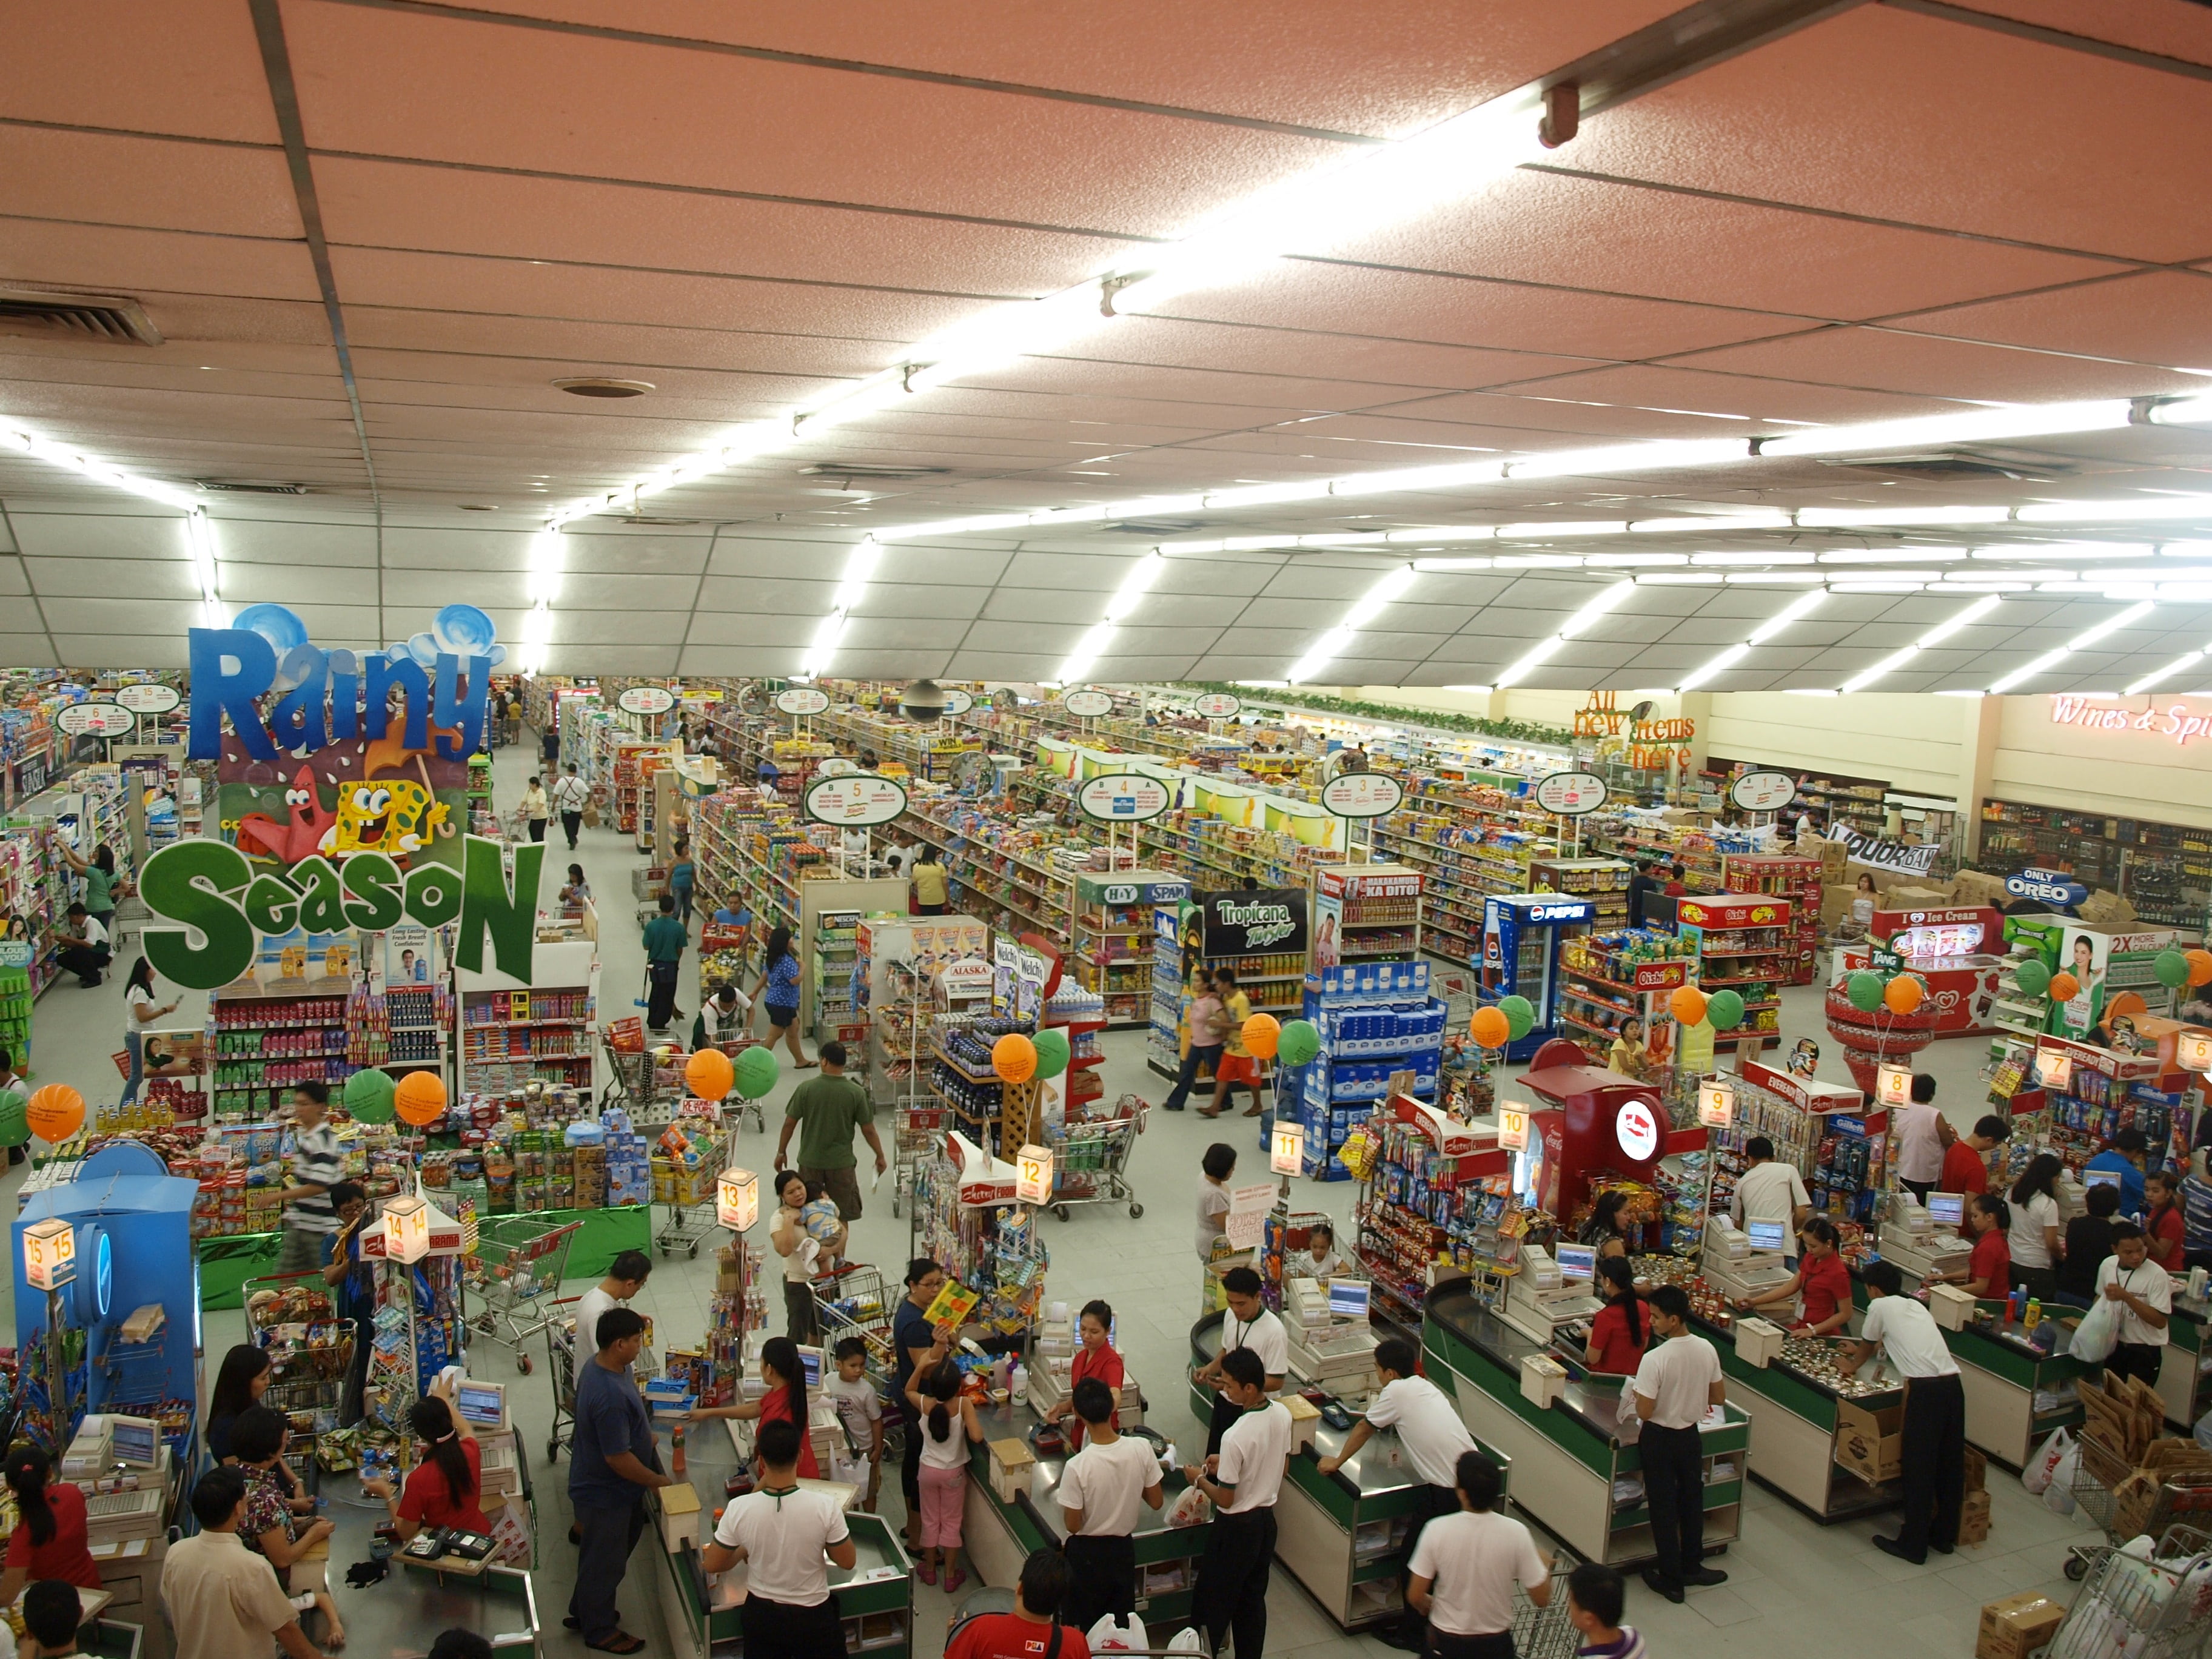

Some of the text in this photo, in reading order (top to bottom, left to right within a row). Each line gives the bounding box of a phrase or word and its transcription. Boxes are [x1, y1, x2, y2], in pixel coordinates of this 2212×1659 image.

[143, 688, 152, 697] 15
[189, 628, 491, 763] Rainy
[1587, 690, 1616, 711] All
[93, 708, 99, 718] 6
[2051, 695, 2212, 745] Wines & Spi
[1573, 710, 1627, 736] new
[1636, 718, 1696, 742] items
[938, 737, 957, 746] WIN
[1633, 742, 1692, 770] here
[853, 783, 861, 797] 5
[1121, 780, 1127, 794] 4
[1360, 779, 1366, 792] 3
[1570, 778, 1576, 790] 2
[1763, 777, 1768, 788] 1
[1905, 848, 1937, 869] BAN
[1367, 877, 1420, 886] MAKAKAMURA
[2023, 869, 2054, 882] ONLY
[1152, 885, 1187, 900] SPAM
[1367, 885, 1420, 897] KA DITO!
[2007, 878, 2070, 902] OREO
[1217, 901, 1290, 926] Tropicana
[1544, 905, 1585, 919] PEPSI
[1725, 909, 1747, 920] Oishi
[1902, 911, 1978, 924] I Ice Cream
[407, 928, 427, 936] Lasting
[1246, 922, 1296, 948] Twister
[2112, 934, 2156, 954] 2X MORE
[2133, 942, 2166, 952] CALCIUM
[997, 943, 1017, 967] Welch's
[1872, 950, 1897, 966] TANG
[952, 967, 987, 976] ALASKA
[1021, 957, 1043, 981] Welch's
[1639, 970, 1664, 985] Oishi
[2064, 1046, 2100, 1067] EVEREADY
[2196, 1042, 2207, 1056] 6
[2054, 1057, 2064, 1073] 7
[1768, 1076, 1796, 1099] EVEREADY
[1892, 1074, 1902, 1091] 8
[1712, 1092, 1723, 1110] 9
[1504, 1113, 1523, 1133] 10
[253, 1138, 277, 1147] CRISPY
[1279, 1136, 1296, 1156] 11
[1022, 1161, 1039, 1182] 12
[722, 1184, 738, 1208] 13
[388, 1215, 403, 1239] 14
[412, 1210, 426, 1236] 14
[28, 1239, 43, 1264] 15
[53, 1232, 72, 1261] 15
